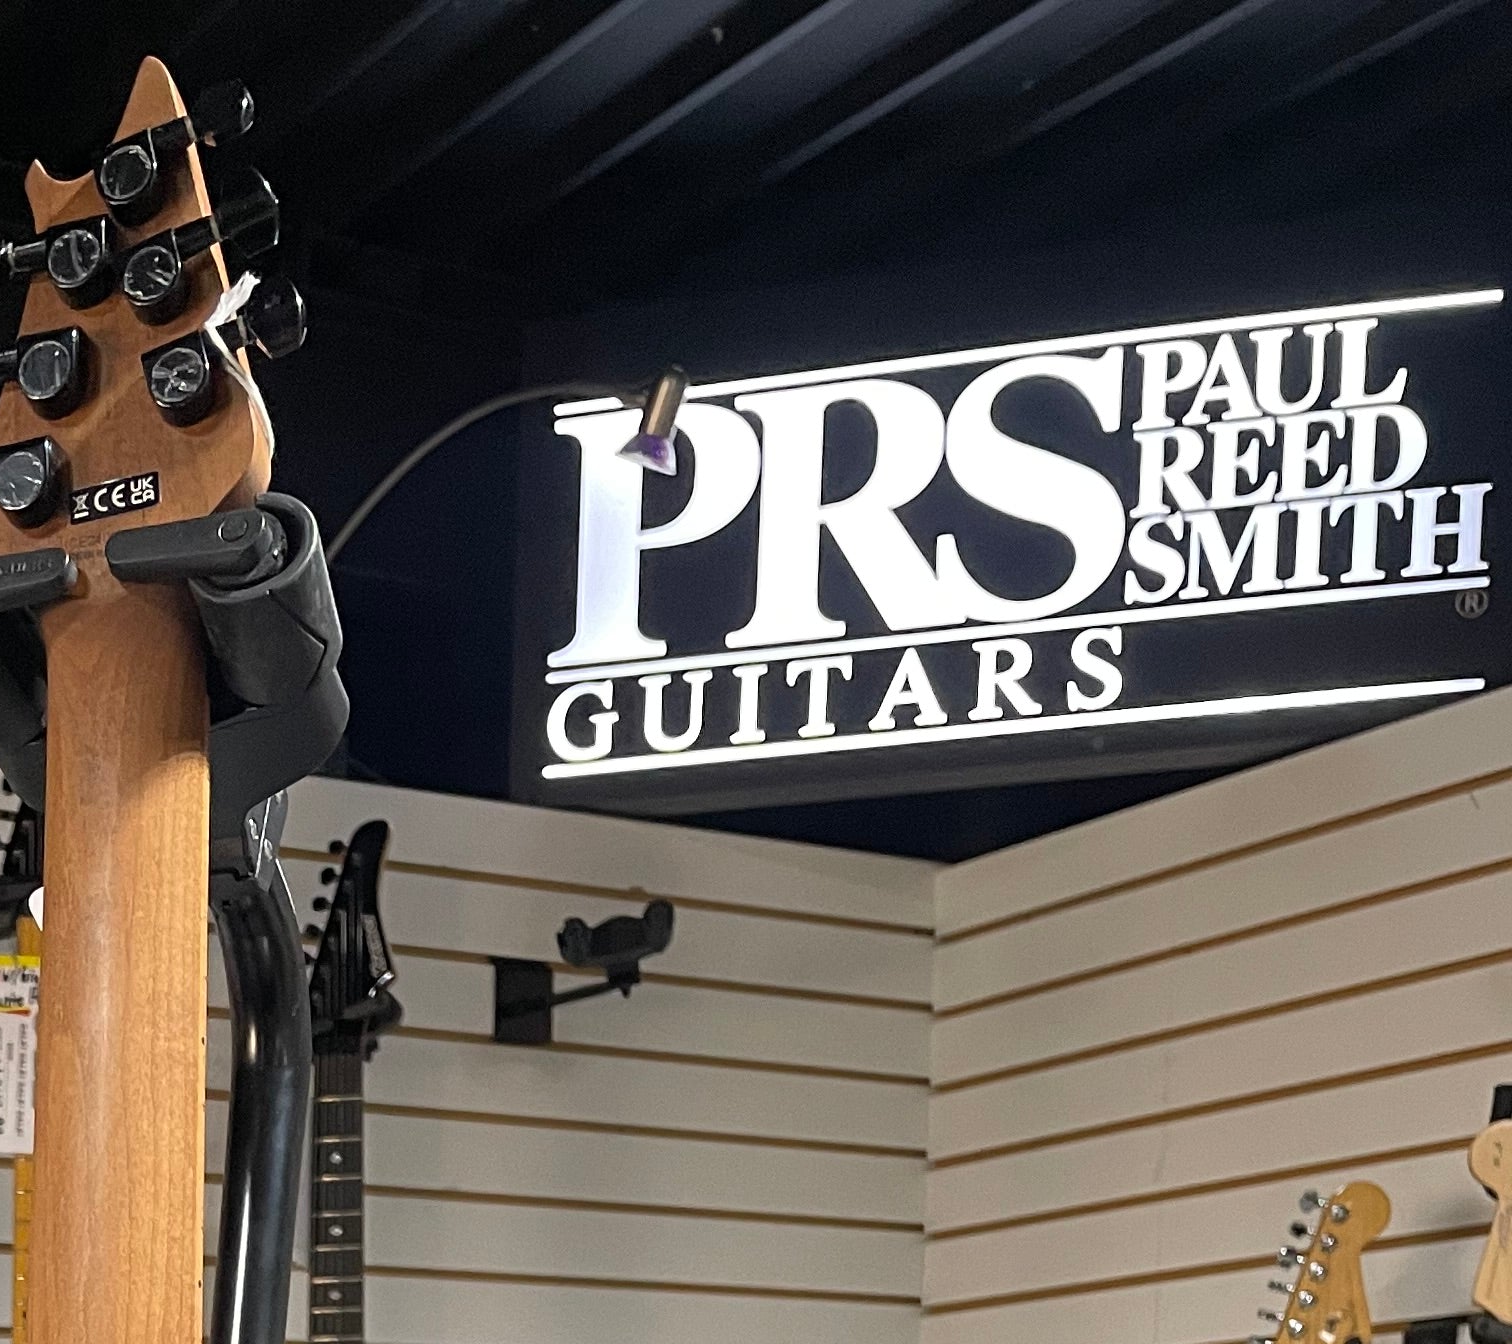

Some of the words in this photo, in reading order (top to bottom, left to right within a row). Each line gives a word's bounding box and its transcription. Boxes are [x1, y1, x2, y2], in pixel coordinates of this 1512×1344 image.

[1135, 318, 1407, 427] PAUL
[93, 483, 126, 512] CE
[130, 475, 154, 492] UK
[130, 489, 155, 505] CA
[546, 346, 1126, 668] PRS
[1130, 403, 1428, 520] REED
[1123, 482, 1492, 604] SMITH
[546, 625, 1124, 761] GUITARS
